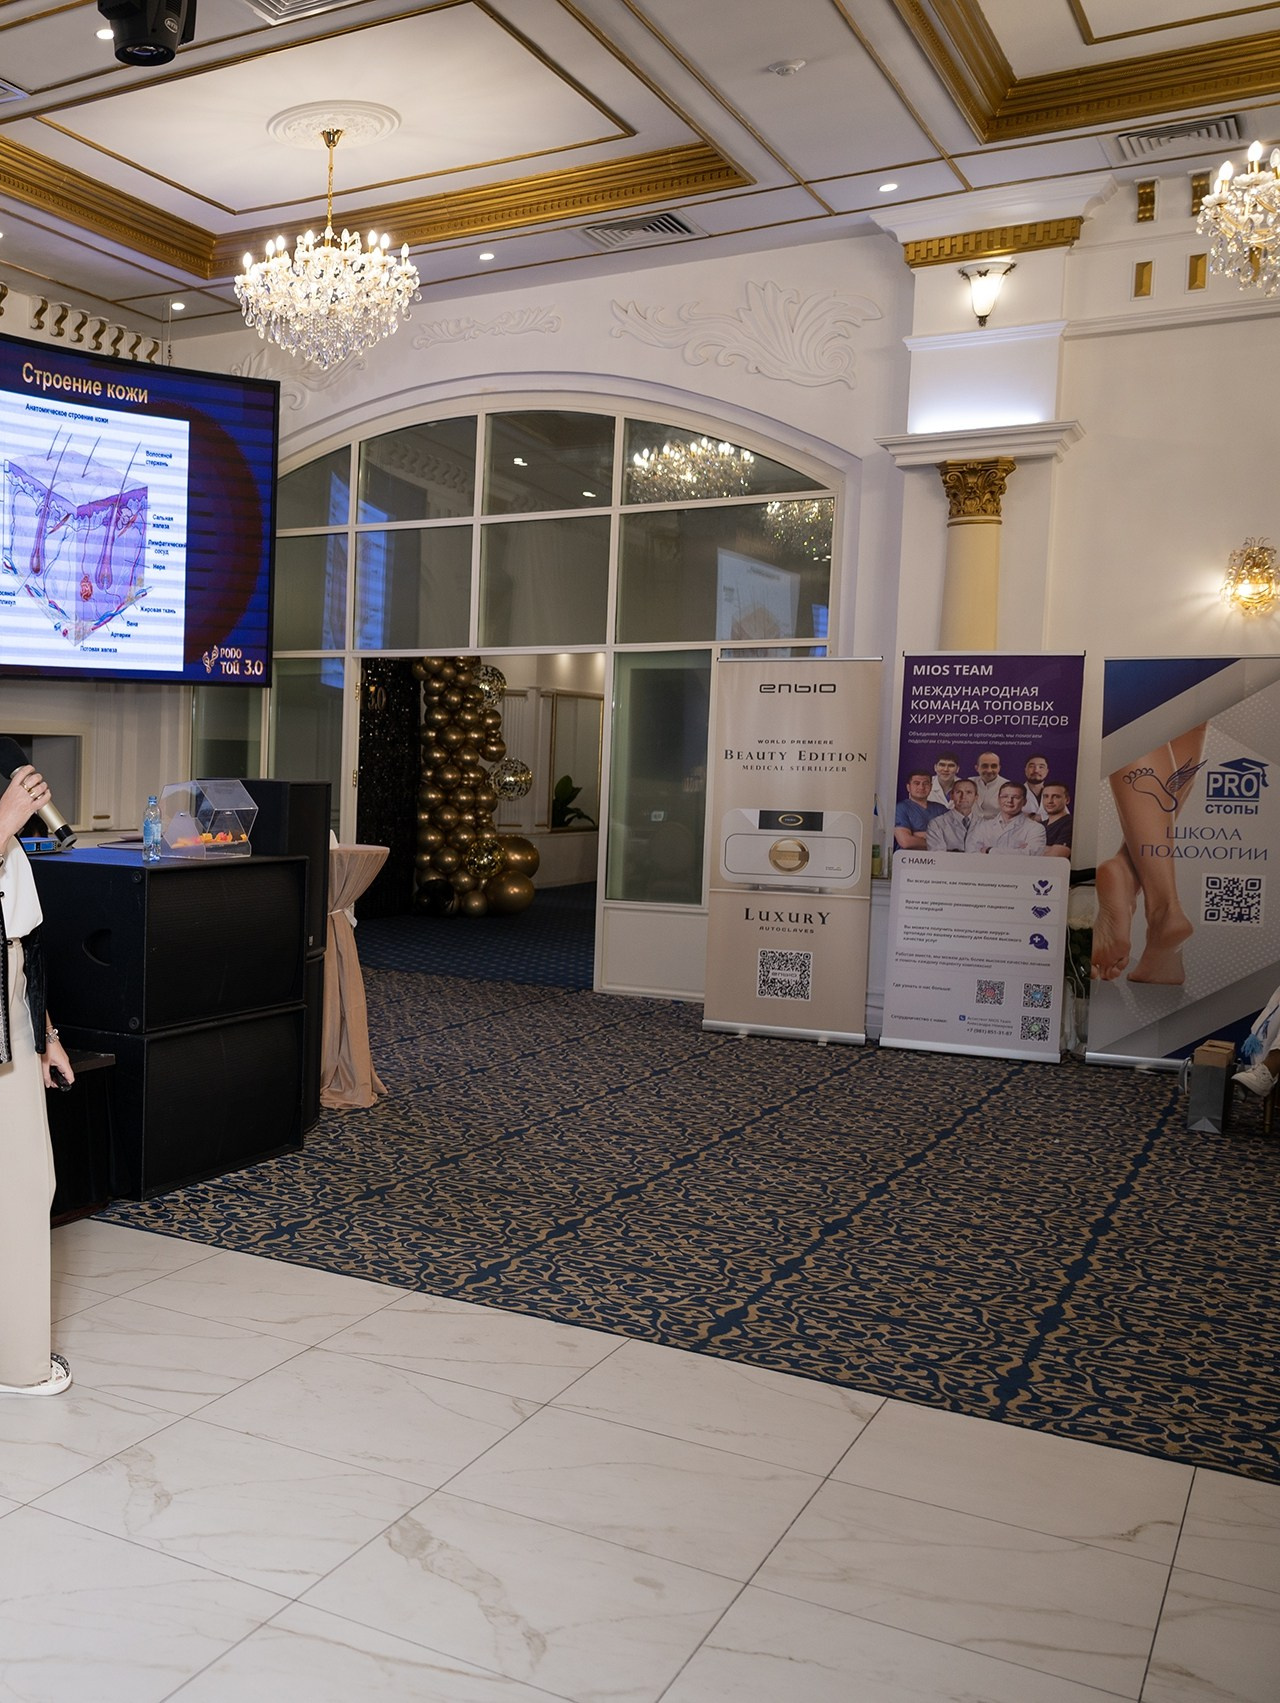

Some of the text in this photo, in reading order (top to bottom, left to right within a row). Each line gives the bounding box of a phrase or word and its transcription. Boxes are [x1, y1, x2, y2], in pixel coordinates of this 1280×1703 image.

[22, 362, 149, 404] Строение кожи
[220, 647, 243, 659] PODO
[244, 659, 263, 676] 3.0
[913, 664, 993, 676] MIOS TEAM
[912, 685, 1039, 698] МЕЖДУНАРОДНАЯ
[910, 699, 1054, 712] КОМАНДА ТОПОВЫХ
[909, 713, 1069, 727] ХИРУРГОВ-ОРТОПЕДОВ
[724, 749, 868, 763] BEAUTY EDITION
[1208, 772, 1258, 798] PRO
[1166, 826, 1242, 841] ШКОЛА
[1141, 844, 1268, 861] ПОДОЛОГИИ
[908, 857, 936, 865] НАМИ:
[745, 907, 830, 925] LUXURY
[759, 926, 814, 934] AUTOCLAVES
